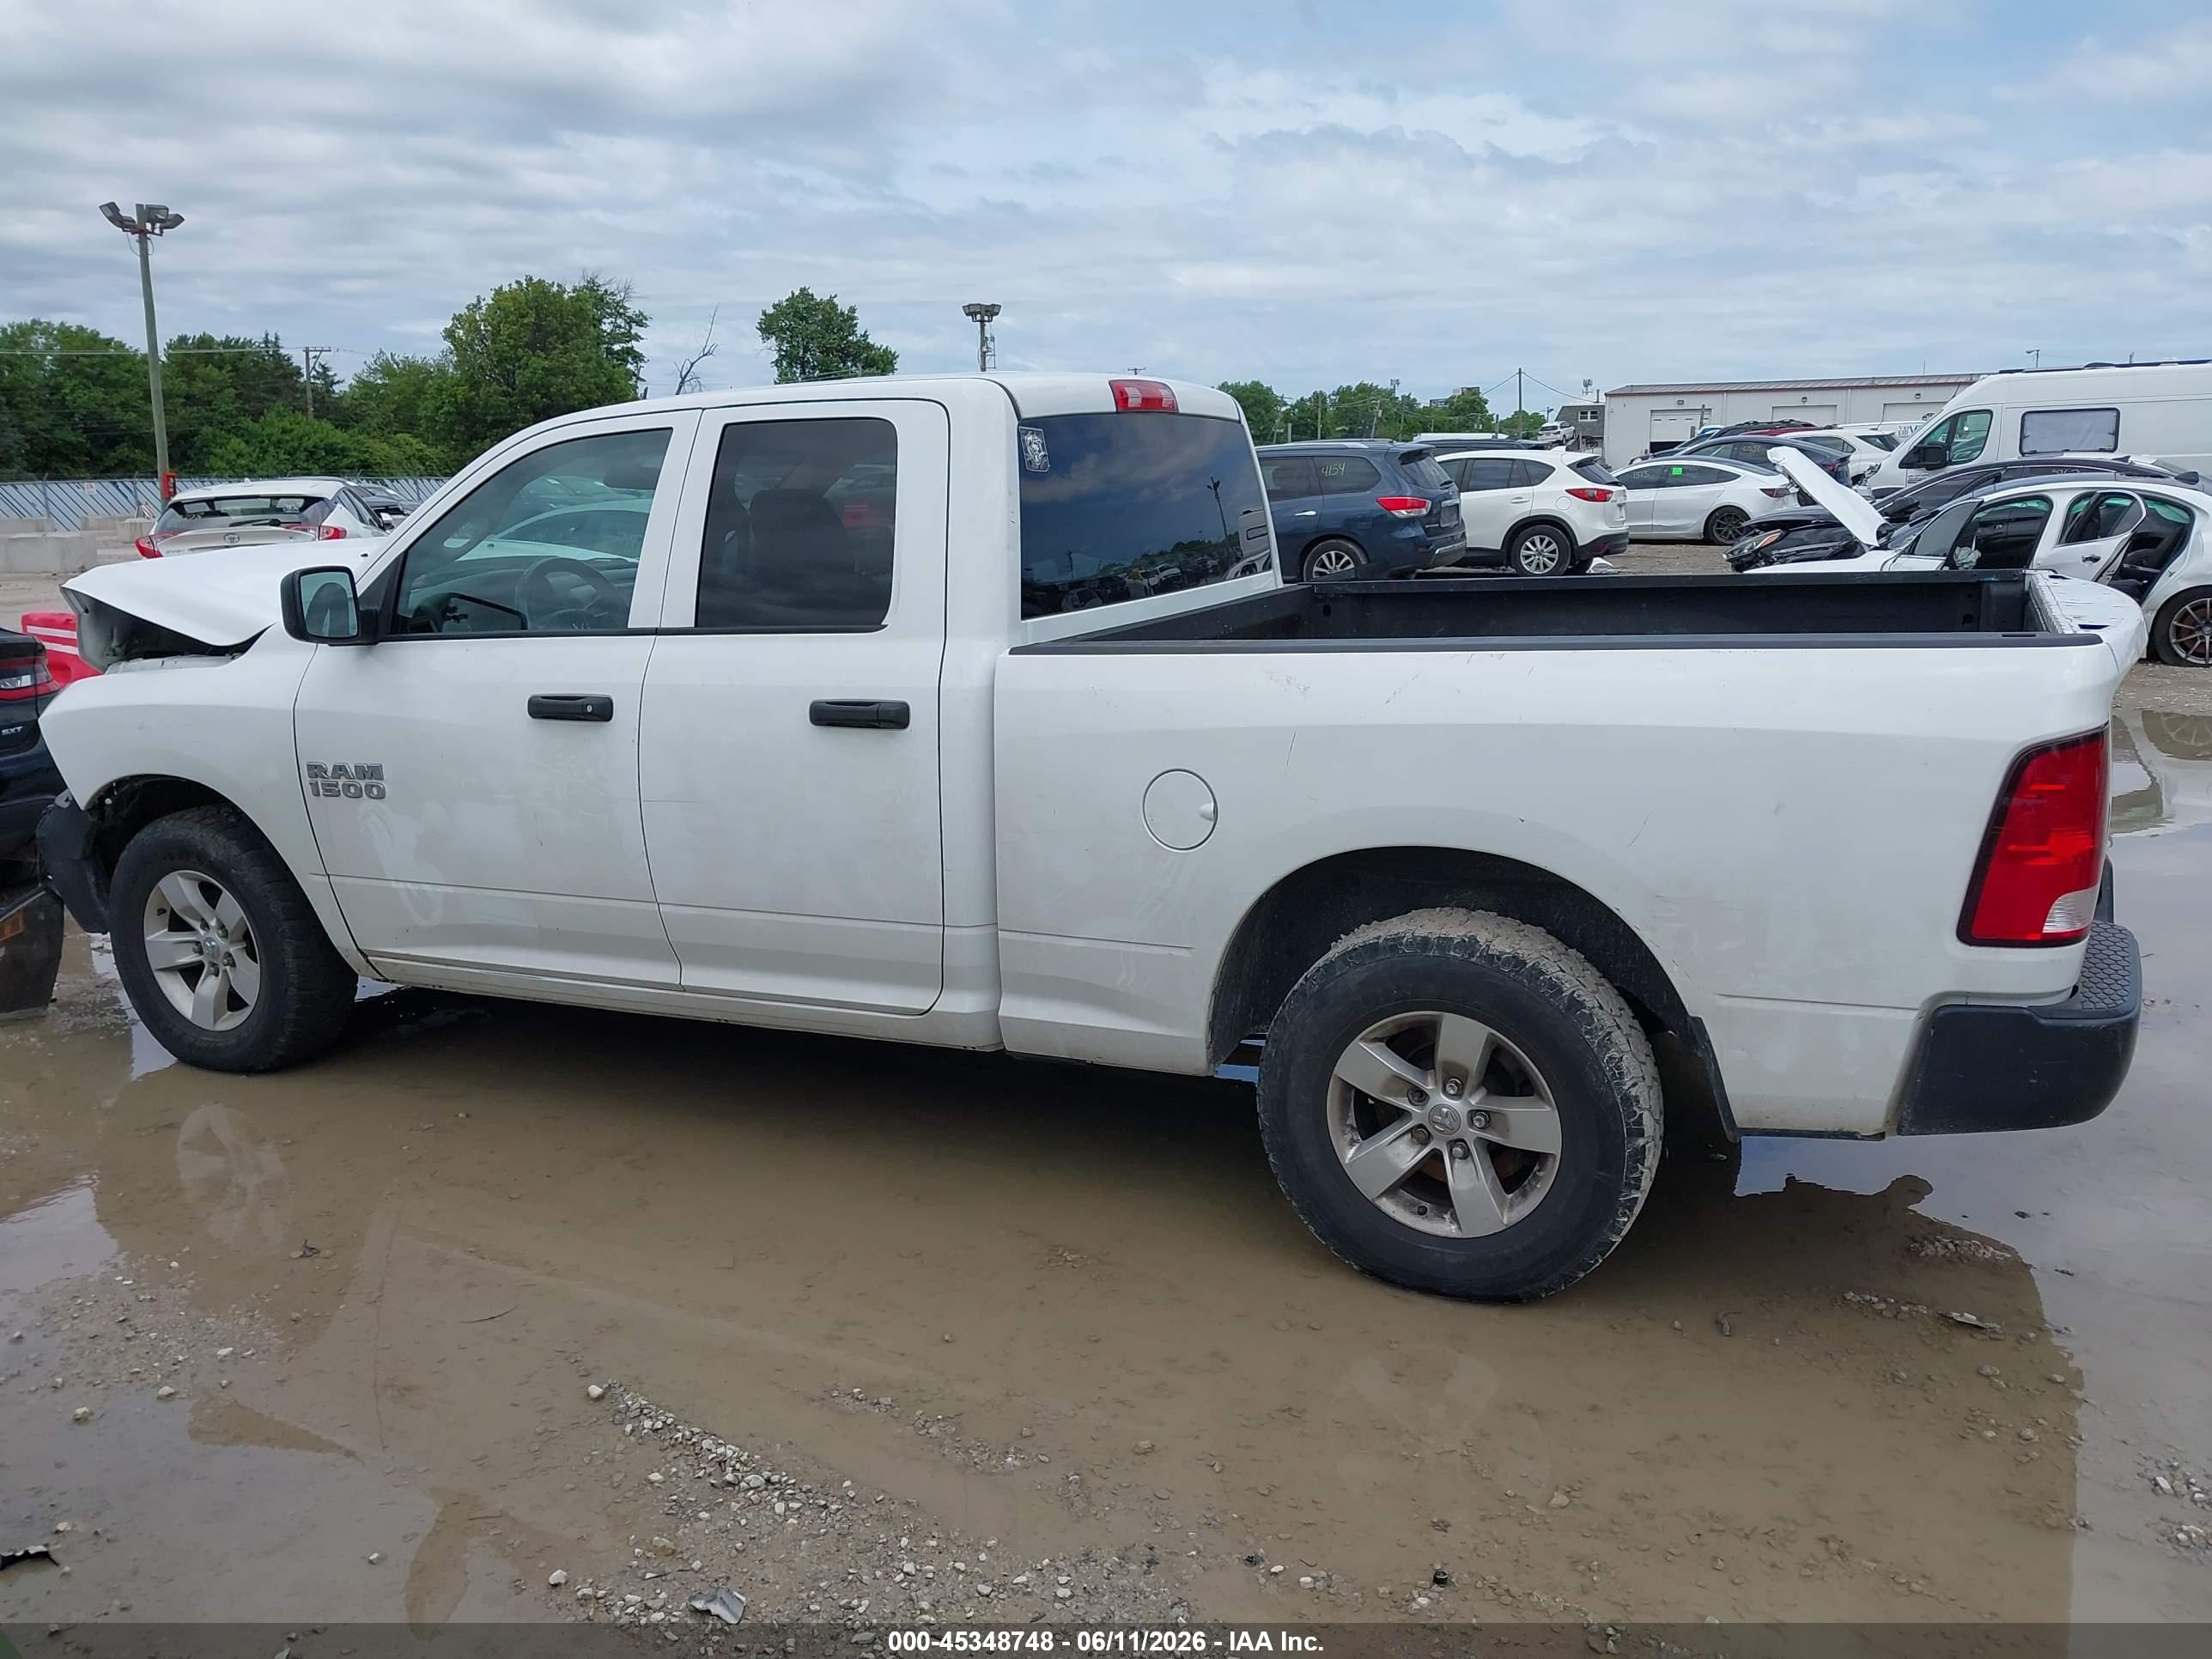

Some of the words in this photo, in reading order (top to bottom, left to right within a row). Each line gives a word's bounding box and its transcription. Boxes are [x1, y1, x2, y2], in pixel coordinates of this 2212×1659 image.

[1321, 461, 1346, 477] 4154
[1, 726, 23, 735] SXT
[306, 762, 385, 781] RAM
[308, 779, 386, 799] 1500
